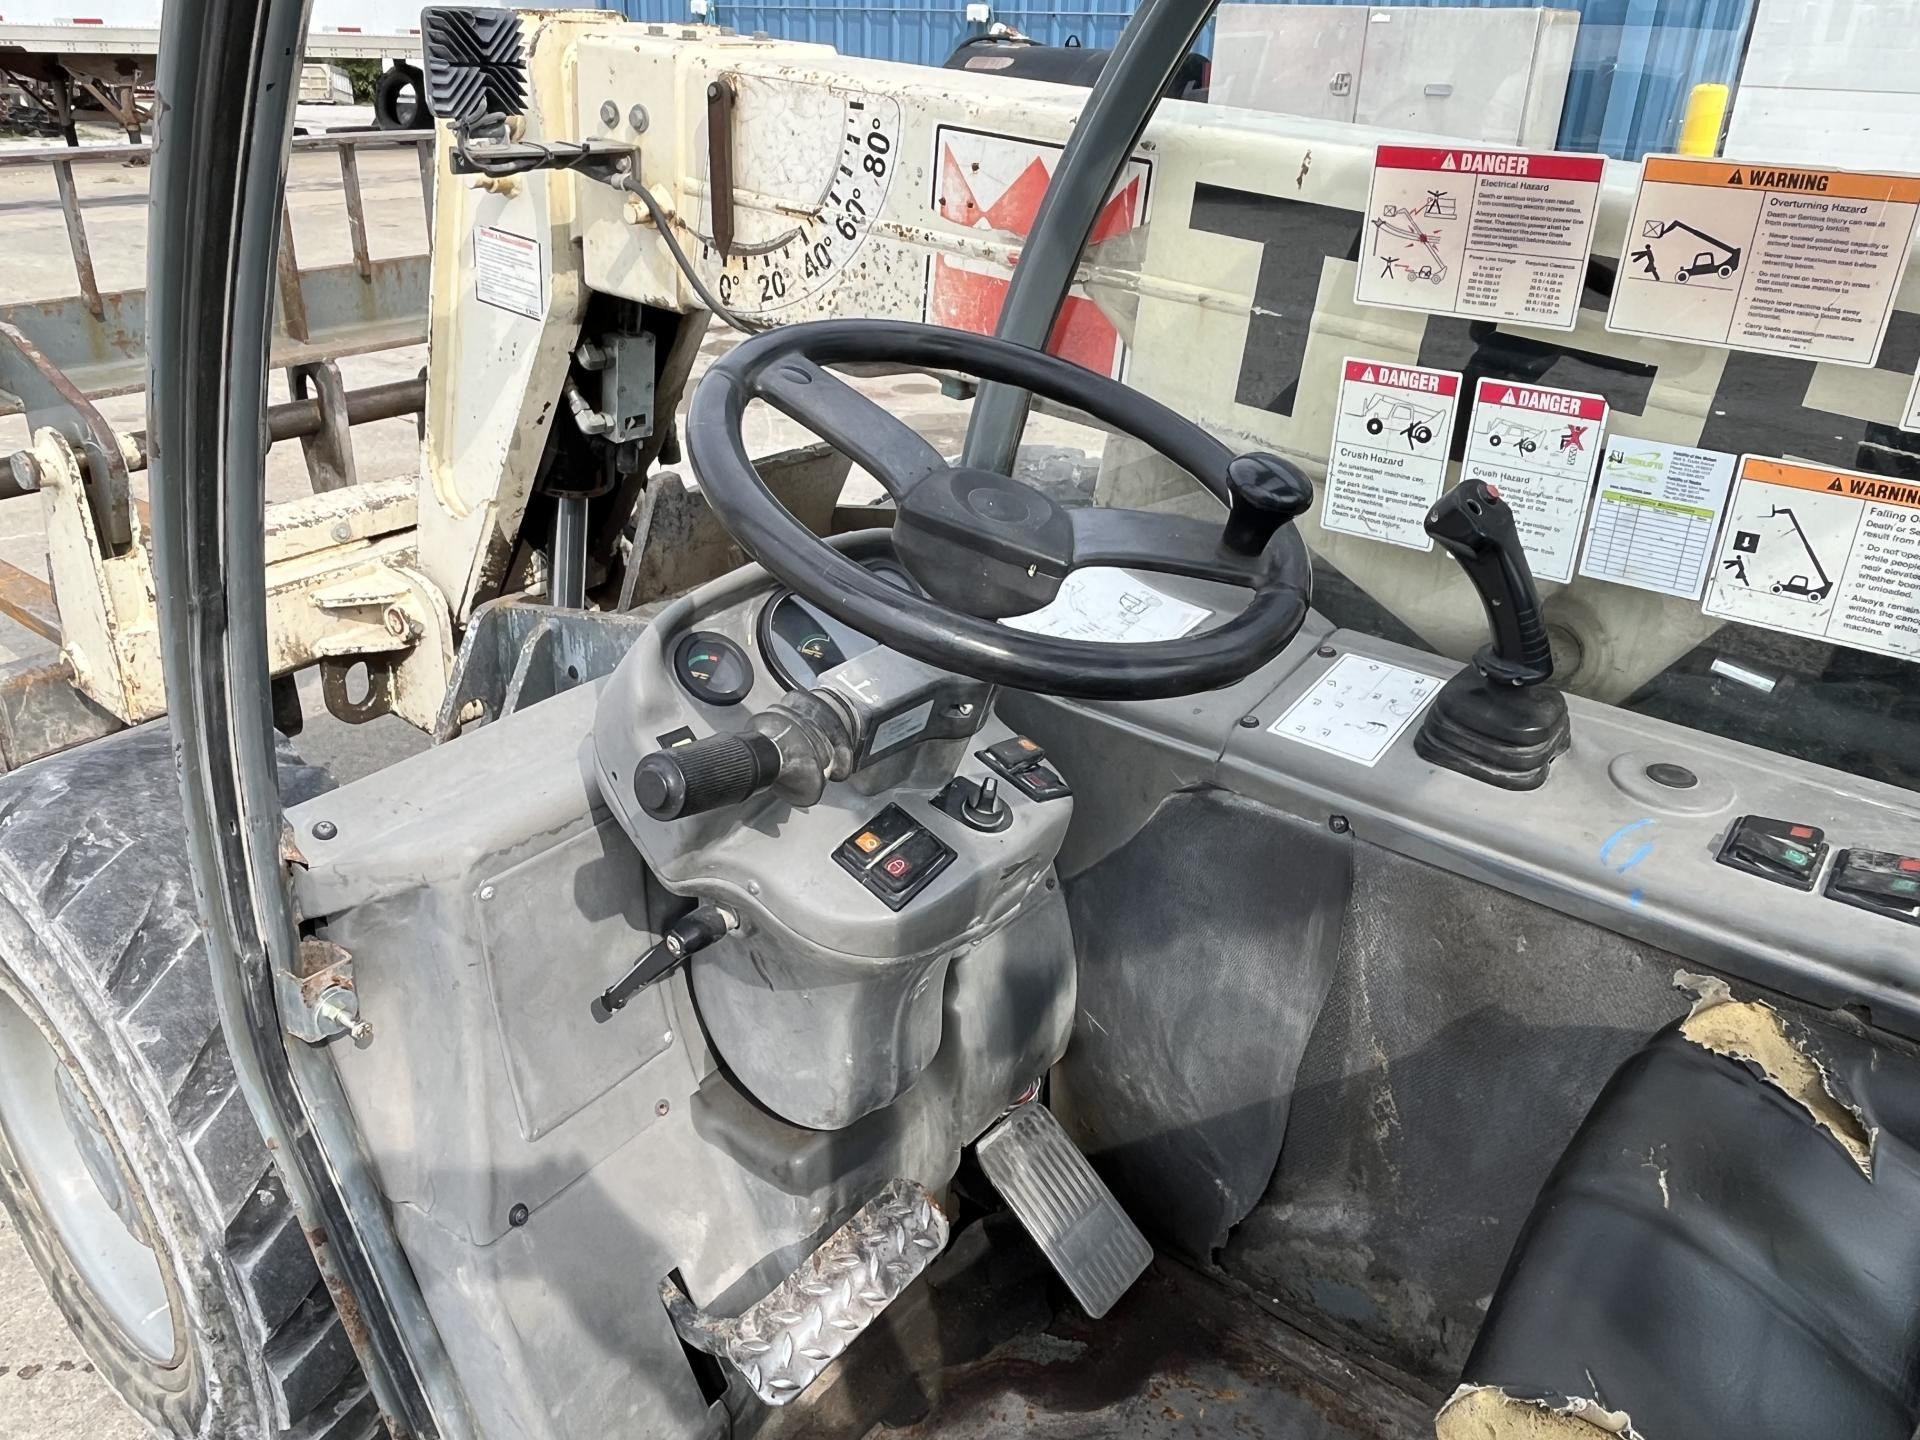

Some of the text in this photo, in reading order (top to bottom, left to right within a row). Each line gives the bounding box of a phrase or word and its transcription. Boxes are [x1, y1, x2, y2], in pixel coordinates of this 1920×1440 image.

[862, 118, 891, 178] 80°
[1460, 152, 1530, 175] DANGER
[1480, 179, 1550, 191] Electrical Hazard
[1749, 169, 1830, 192] WARNING
[1770, 198, 1868, 214] Overturning Hazard
[803, 236, 832, 280] 40°
[719, 274, 740, 306] 0°
[1378, 367, 1440, 393] DANGER
[1518, 392, 1582, 416] DANGER
[1340, 447, 1404, 467] Crush Hazard
[1472, 467, 1530, 484] Crush Hazard
[1850, 479, 1920, 506] WARNIN
[1869, 507, 1907, 523] Falling
[1866, 519, 1894, 531] Death
[1863, 530, 1915, 545] result from
[1867, 543, 1880, 552] Do
[1864, 554, 1889, 564] while
[1850, 594, 1884, 608] Always
[1848, 605, 1876, 615] within
